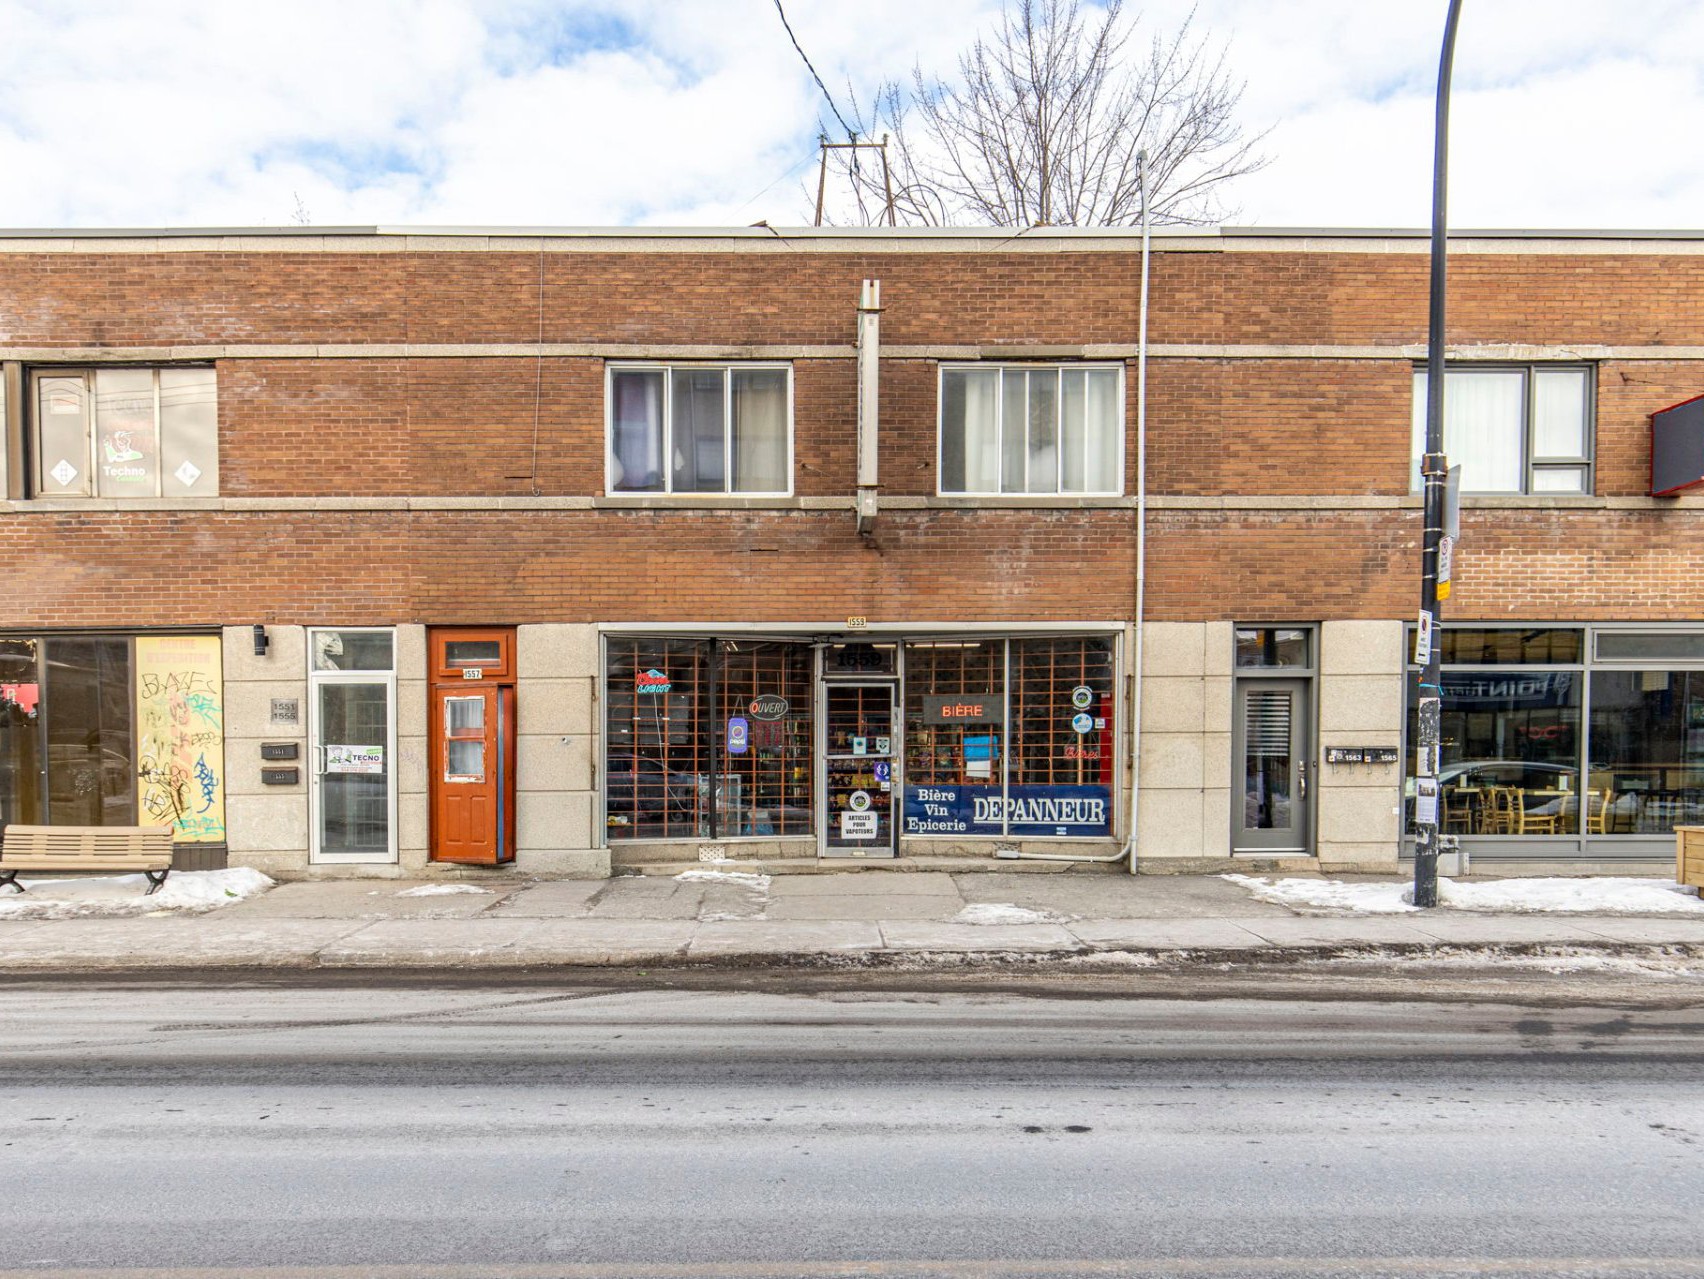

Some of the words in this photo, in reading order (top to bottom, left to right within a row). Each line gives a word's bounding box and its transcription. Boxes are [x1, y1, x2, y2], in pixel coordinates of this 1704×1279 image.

[103, 465, 146, 477] Techno
[849, 617, 865, 626] 1559
[464, 670, 480, 678] 1557
[274, 703, 296, 711] 1551
[751, 702, 785, 714] OUVERT
[942, 702, 983, 717] BIÈRE
[274, 712, 296, 720] 1555
[353, 754, 380, 762] TECNO
[918, 788, 956, 801] Bière
[924, 803, 949, 816] Vin
[973, 796, 1106, 822] DEPANNEUR
[907, 816, 967, 834] Epicerie
